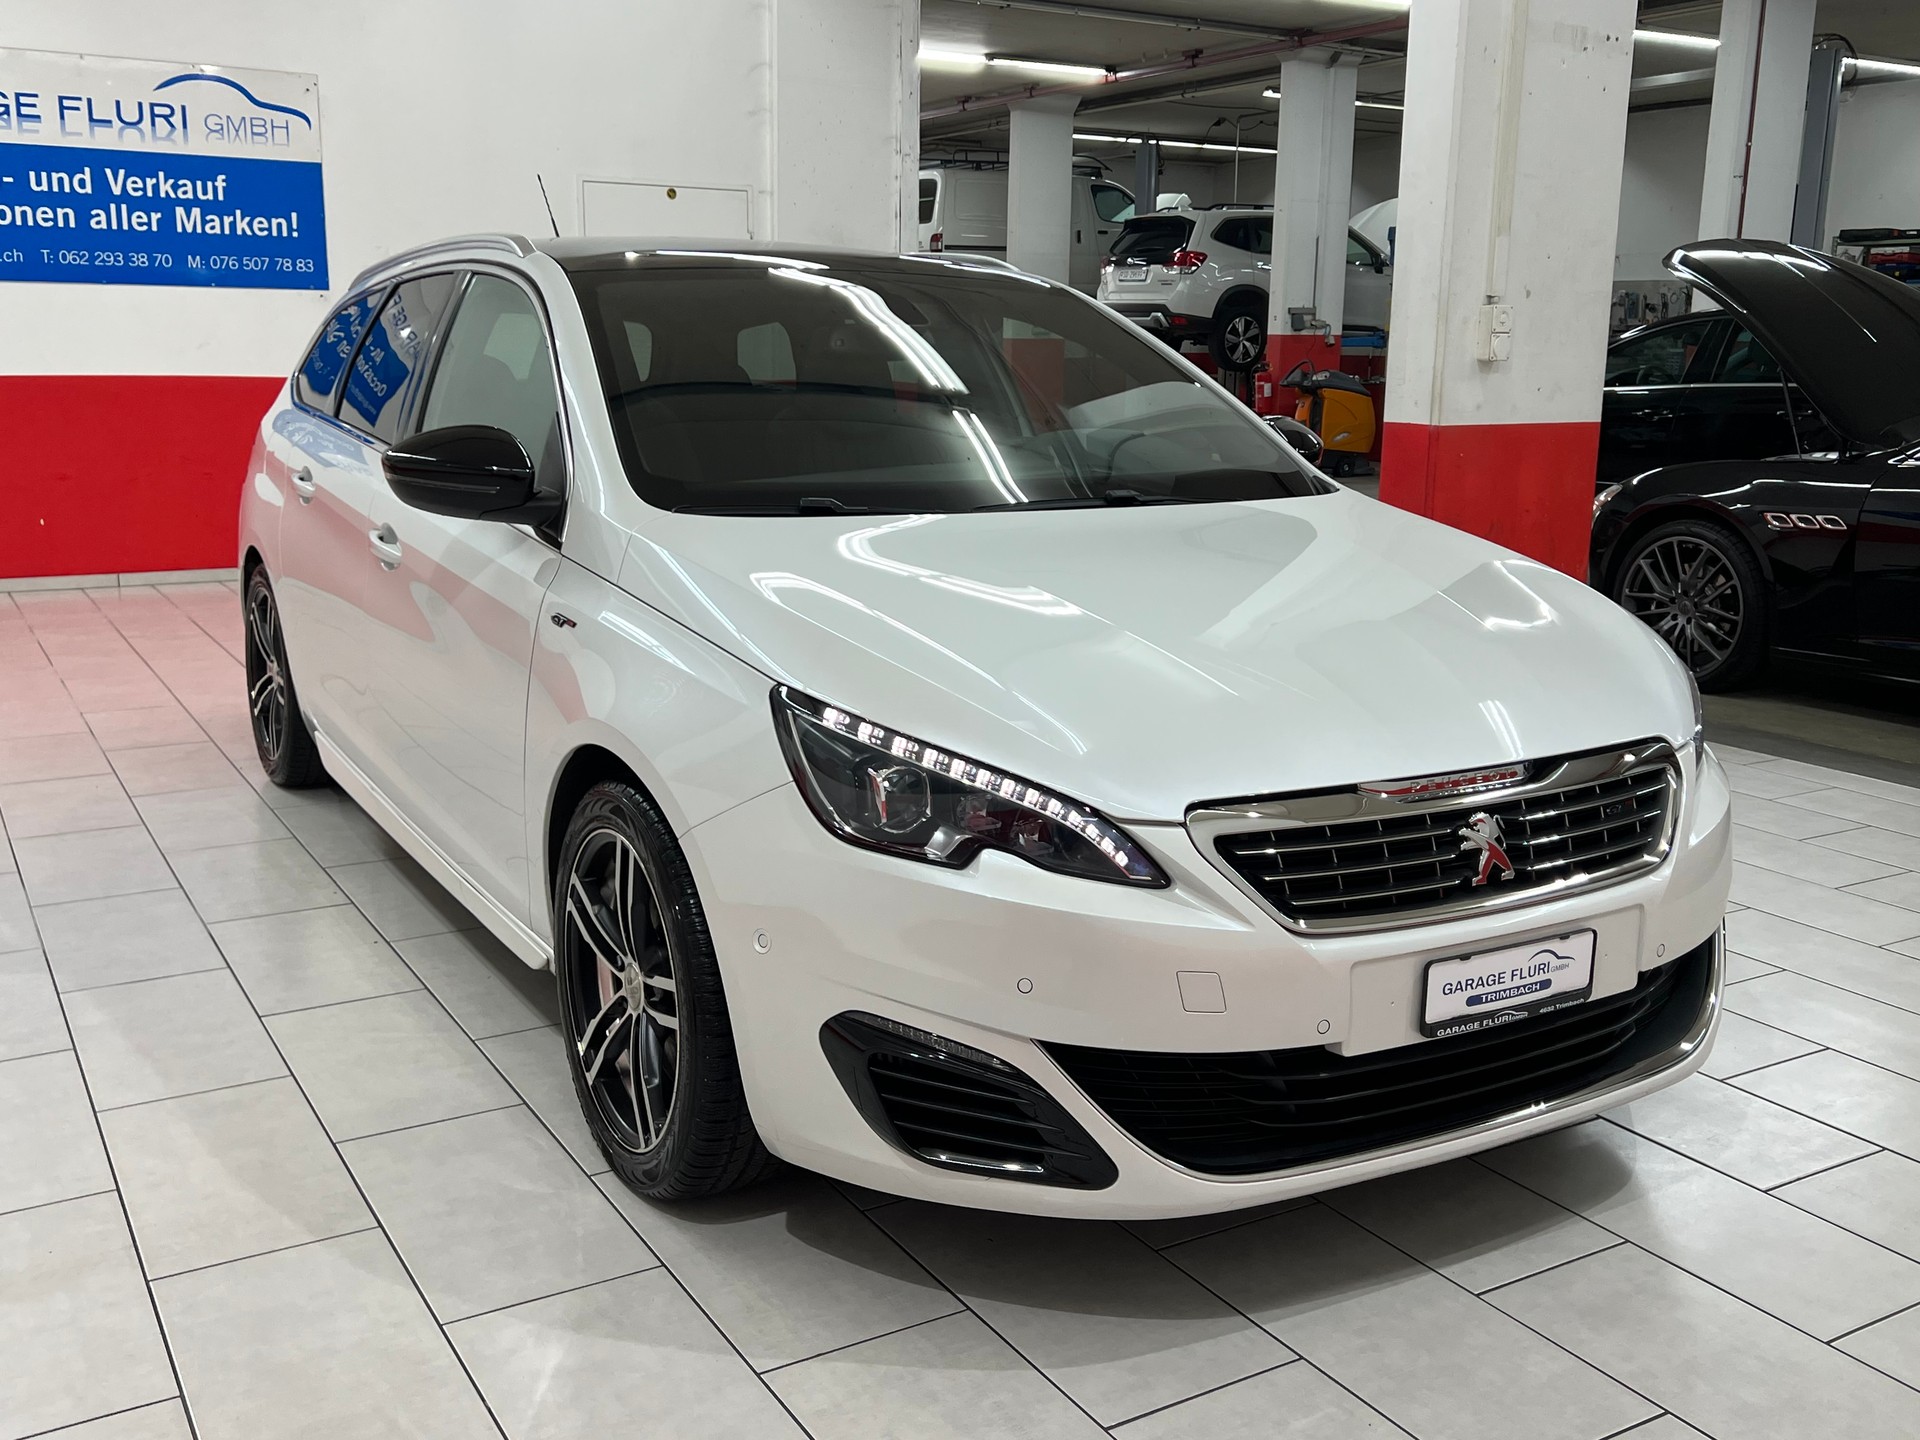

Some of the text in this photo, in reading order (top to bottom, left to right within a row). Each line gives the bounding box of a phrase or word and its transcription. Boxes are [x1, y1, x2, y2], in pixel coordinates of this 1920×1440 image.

[57, 95, 188, 130] FLURI
[204, 113, 290, 138] GMBH
[28, 166, 92, 194] und
[104, 167, 226, 201] Verkauf
[90, 203, 162, 232] aller
[175, 206, 299, 238] Marken!
[40, 249, 54, 264] T:
[58, 250, 89, 265] 062
[94, 251, 124, 267] 293
[128, 252, 148, 267] 38
[153, 253, 173, 268] 70
[188, 255, 206, 269] M:
[210, 255, 239, 270] 076
[243, 256, 269, 271] 507
[275, 258, 293, 272] 78
[296, 259, 314, 273] 83
[1410, 767, 1516, 793] PEUGEOT
[1442, 971, 1506, 996] GARAGE
[1510, 961, 1550, 982] FLURI
[1480, 983, 1540, 1003] TRIMBACH
[1437, 1021, 1480, 1037] GARAGE
[1483, 1014, 1512, 1027] FLURI
[1556, 998, 1584, 1010] Trimbach
